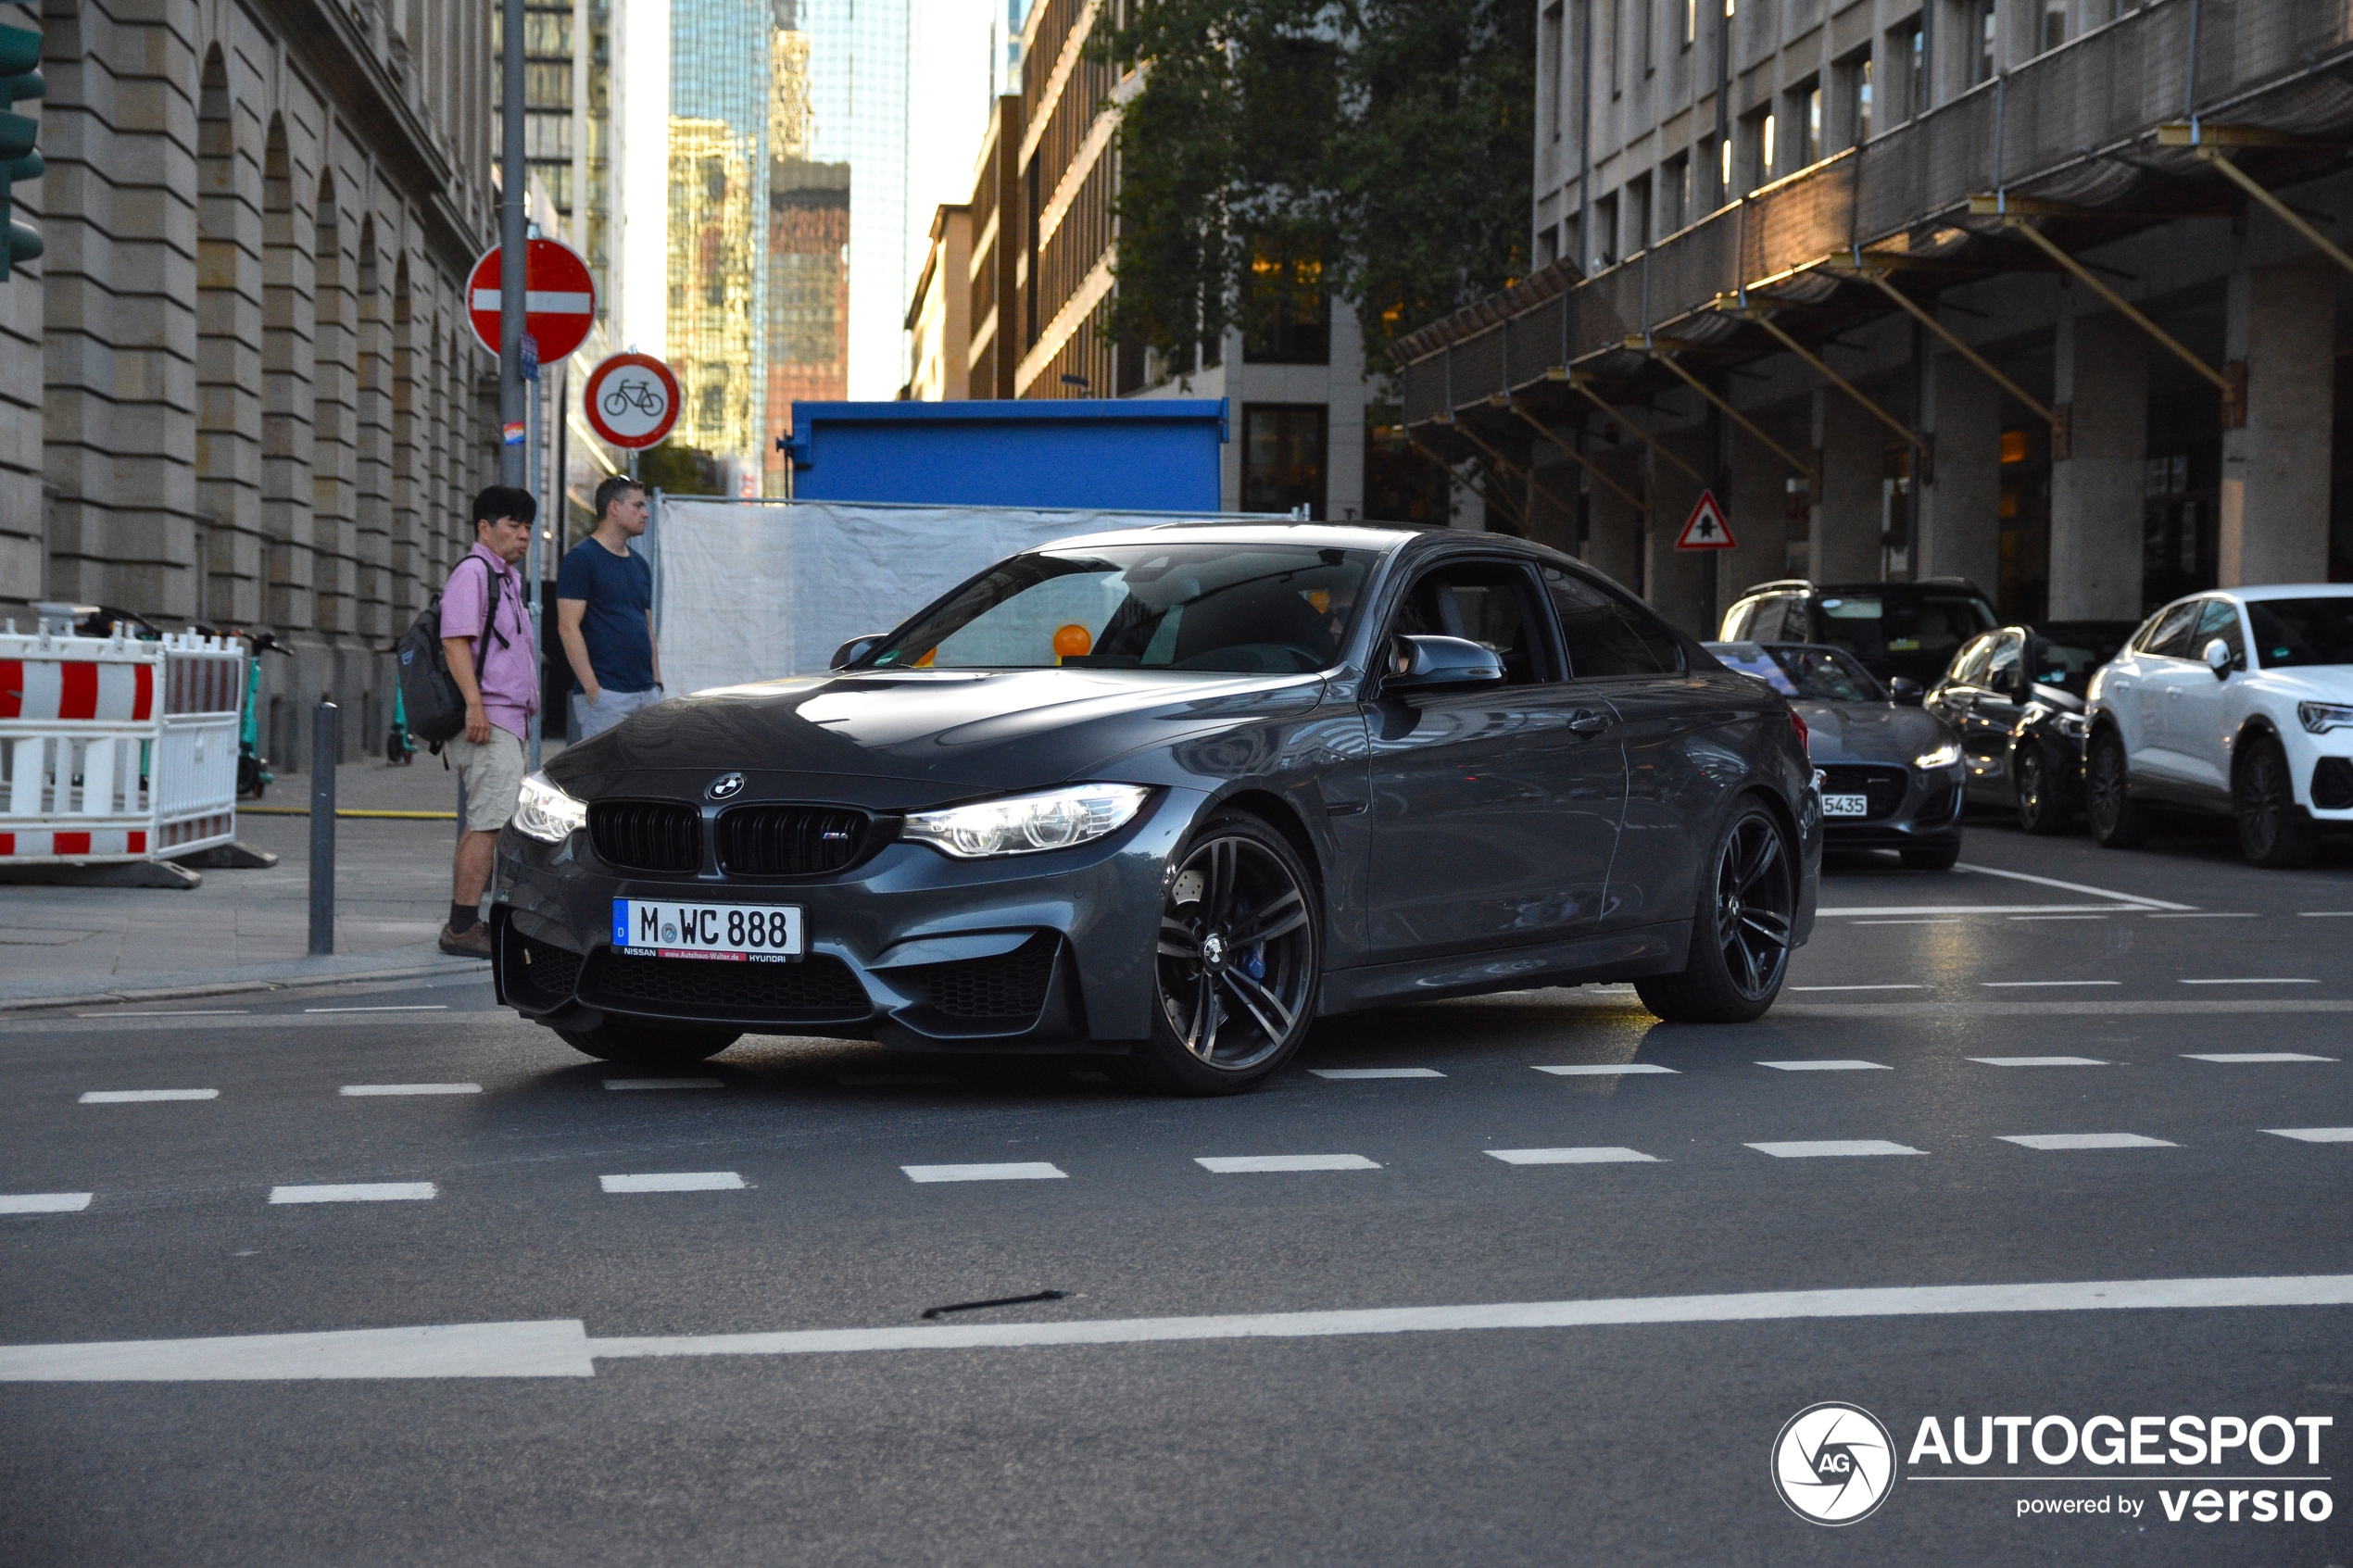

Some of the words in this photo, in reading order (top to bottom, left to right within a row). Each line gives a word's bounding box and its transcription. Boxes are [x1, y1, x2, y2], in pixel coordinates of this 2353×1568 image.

[1825, 797, 1865, 813] 5435
[618, 927, 624, 937] D
[641, 907, 659, 942] M
[680, 909, 719, 945] WC
[727, 910, 787, 947] 888
[623, 947, 657, 957] NISSAN
[664, 951, 739, 961] www.Autohaus-Walter.de
[749, 955, 786, 963] HYUNDAI
